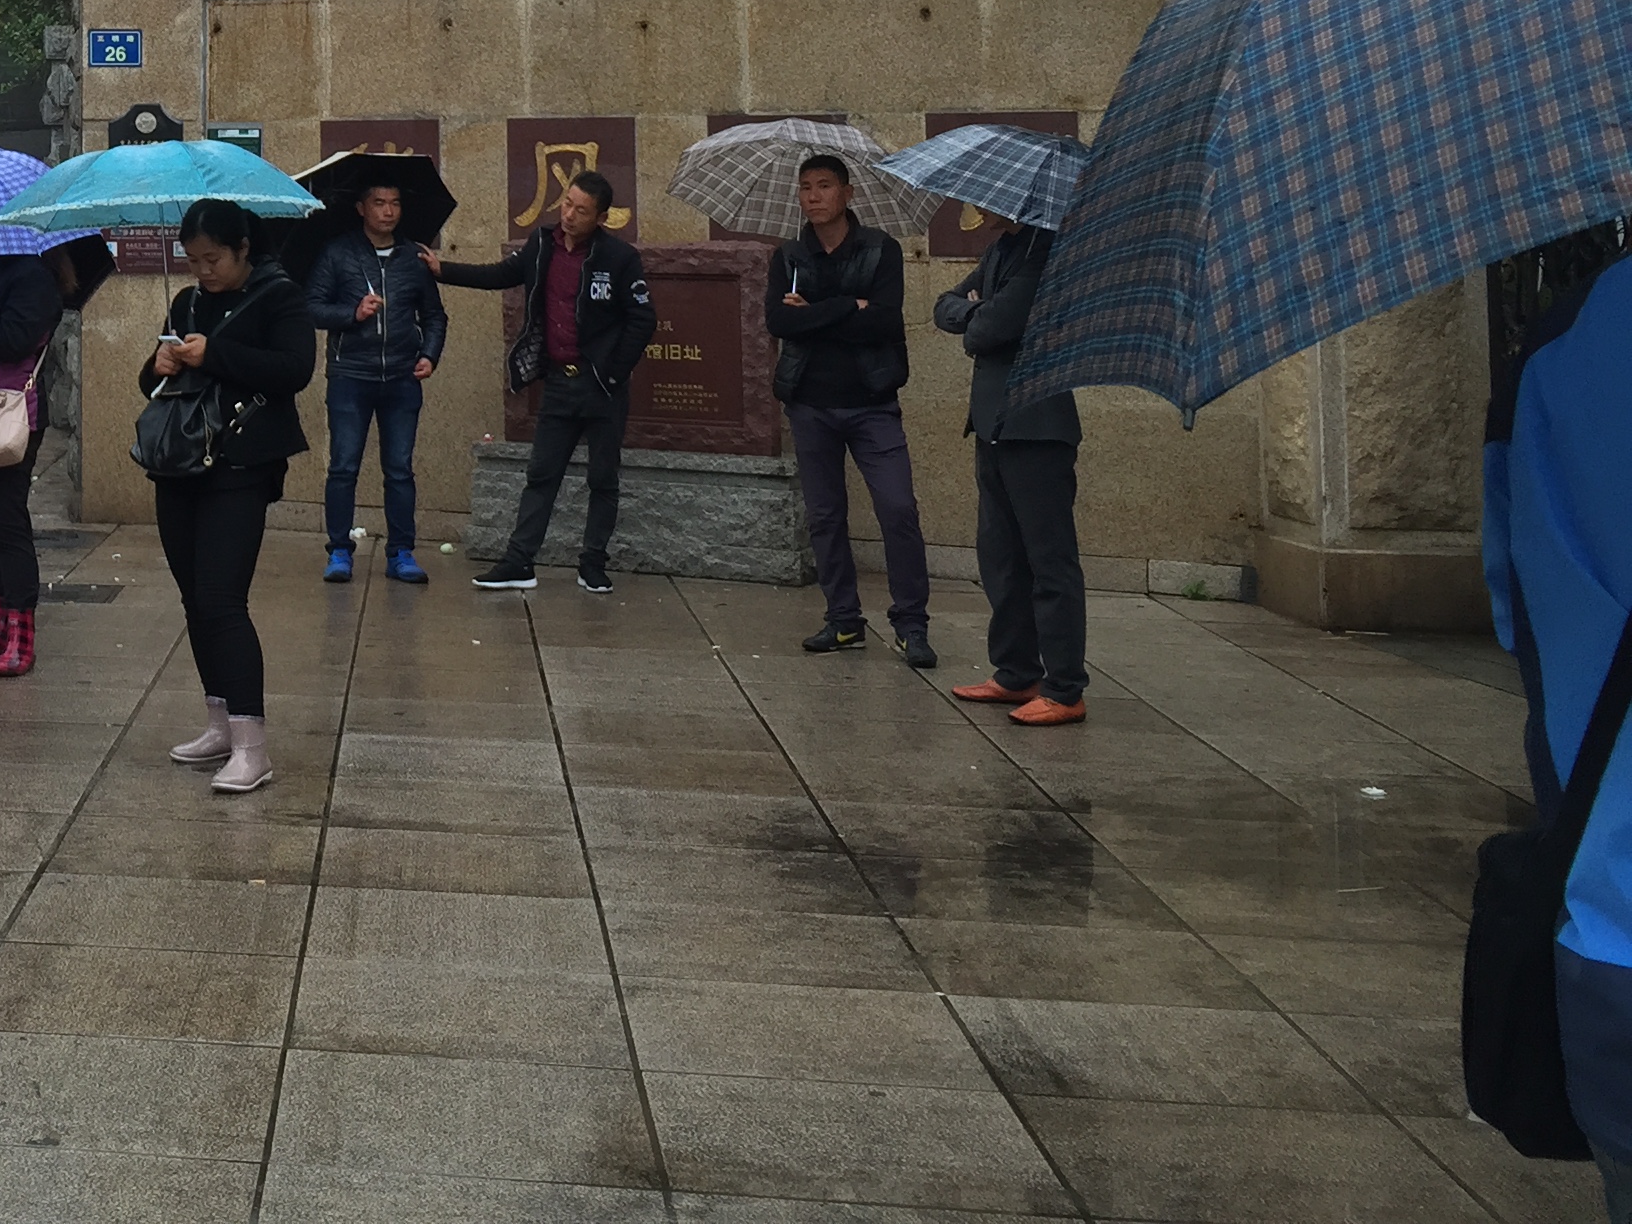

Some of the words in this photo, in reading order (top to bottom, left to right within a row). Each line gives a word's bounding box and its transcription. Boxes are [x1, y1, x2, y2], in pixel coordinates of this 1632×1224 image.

[105, 45, 127, 62] 26
[644, 343, 703, 361] 馆旧址
